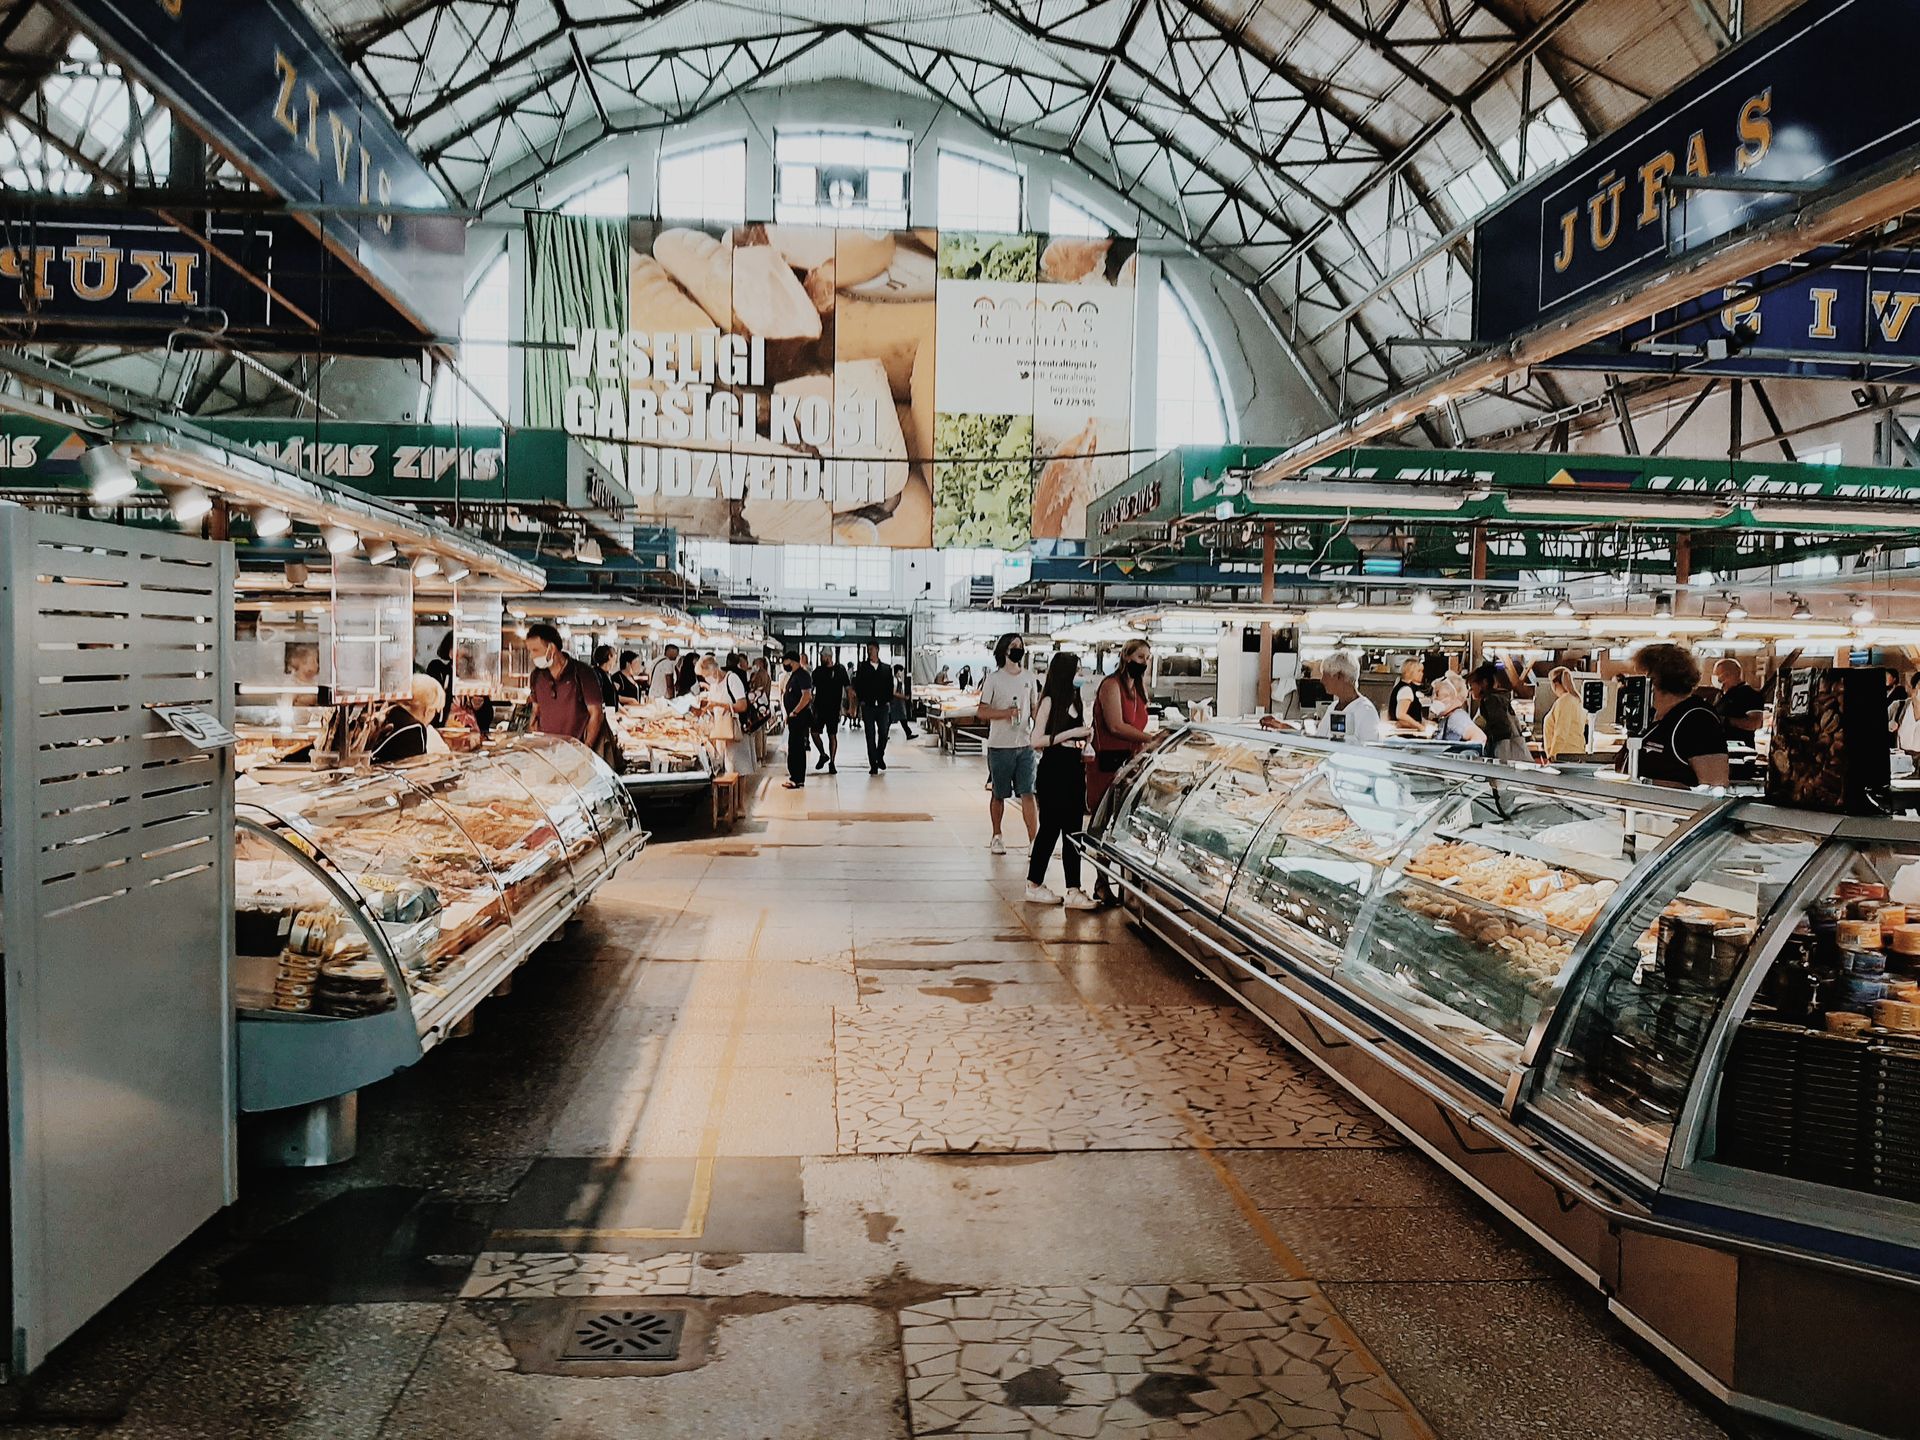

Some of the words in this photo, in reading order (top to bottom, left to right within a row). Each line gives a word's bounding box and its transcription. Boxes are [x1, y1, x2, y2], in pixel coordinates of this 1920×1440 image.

[272, 44, 392, 236] ZIVIS
[1552, 85, 1773, 274] JŪRAS
[563, 327, 766, 386] VESELĪGI
[564, 380, 758, 443] GARŠĪGI
[0, 432, 41, 469] IS
[392, 444, 501, 483] ZIVIS
[598, 445, 887, 504] AUDZVEIDĪGI
